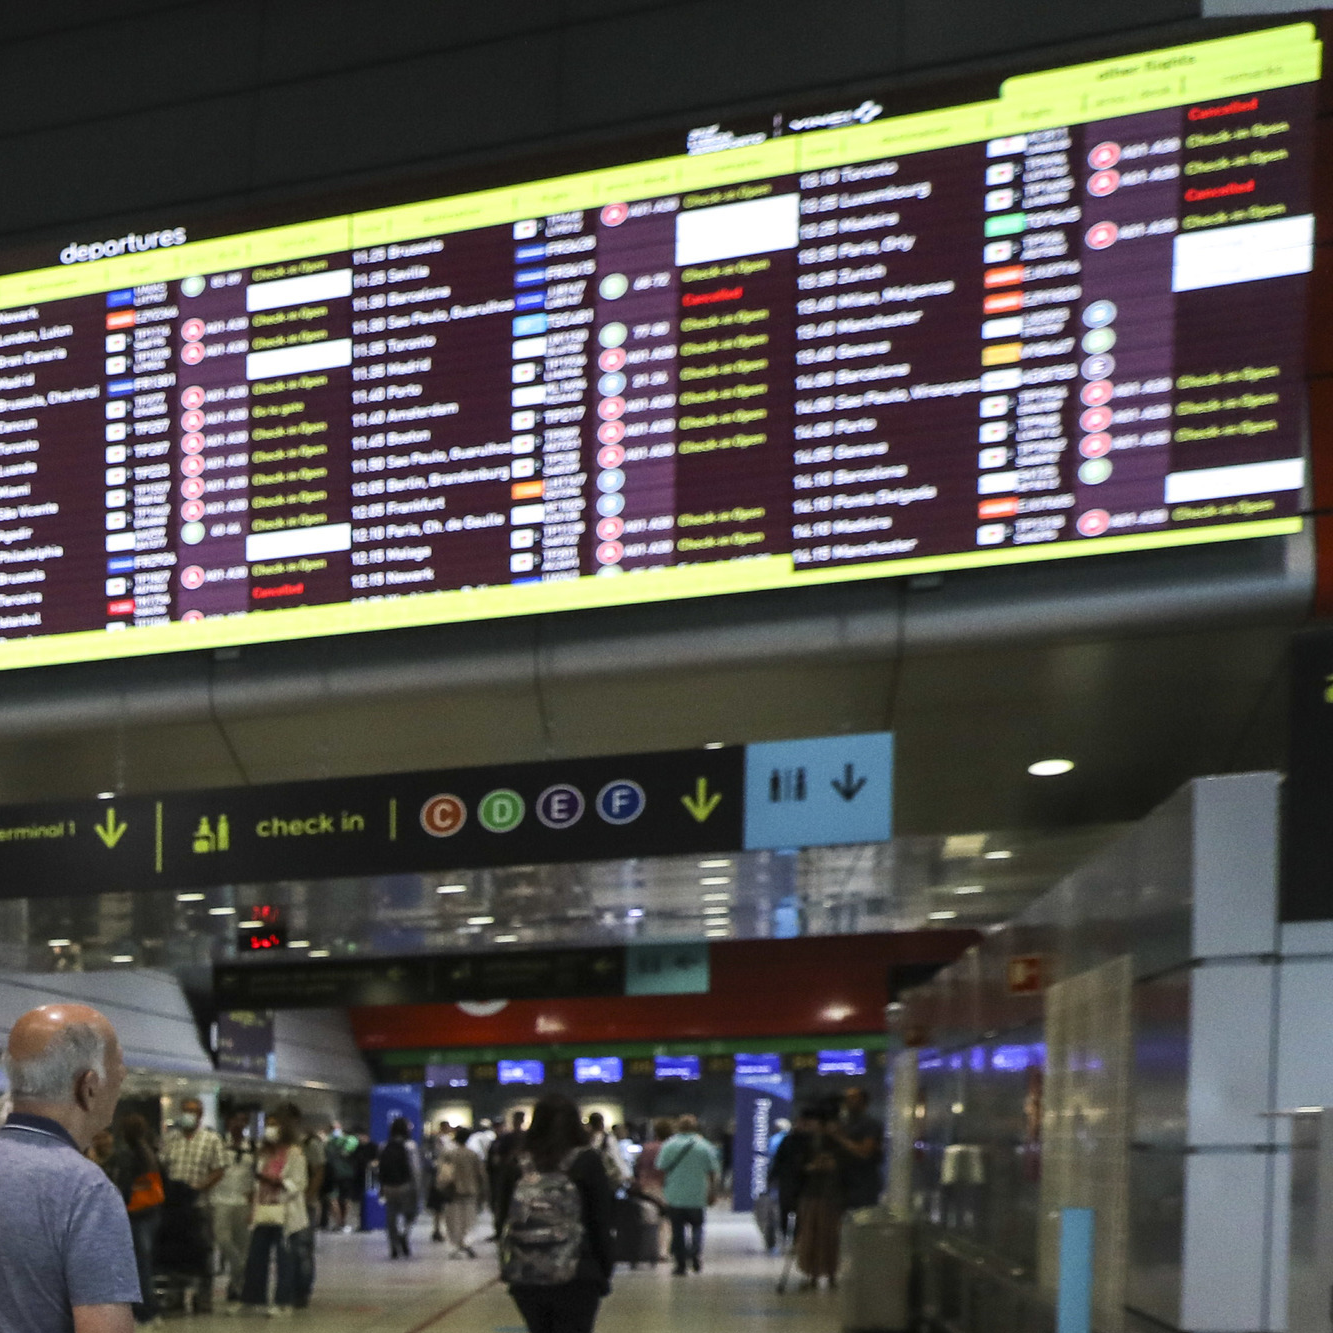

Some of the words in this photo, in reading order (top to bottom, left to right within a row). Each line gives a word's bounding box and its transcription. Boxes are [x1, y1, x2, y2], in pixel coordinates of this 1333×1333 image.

[59, 226, 186, 265] departures
[298, 260, 328, 272] Open
[39, 325, 72, 339] Luton
[22, 346, 66, 363] Canaria
[298, 375, 327, 389] Open
[273, 402, 304, 416] gate
[298, 422, 327, 434] Open
[298, 468, 326, 480] Open
[428, 466, 509, 486] Brandenburg
[251, 582, 305, 599] Cancelled
[549, 793, 569, 820] E
[611, 788, 631, 814] F
[435, 803, 455, 829] C
[493, 797, 512, 824] D
[256, 813, 334, 838] check
[341, 811, 365, 832] in
